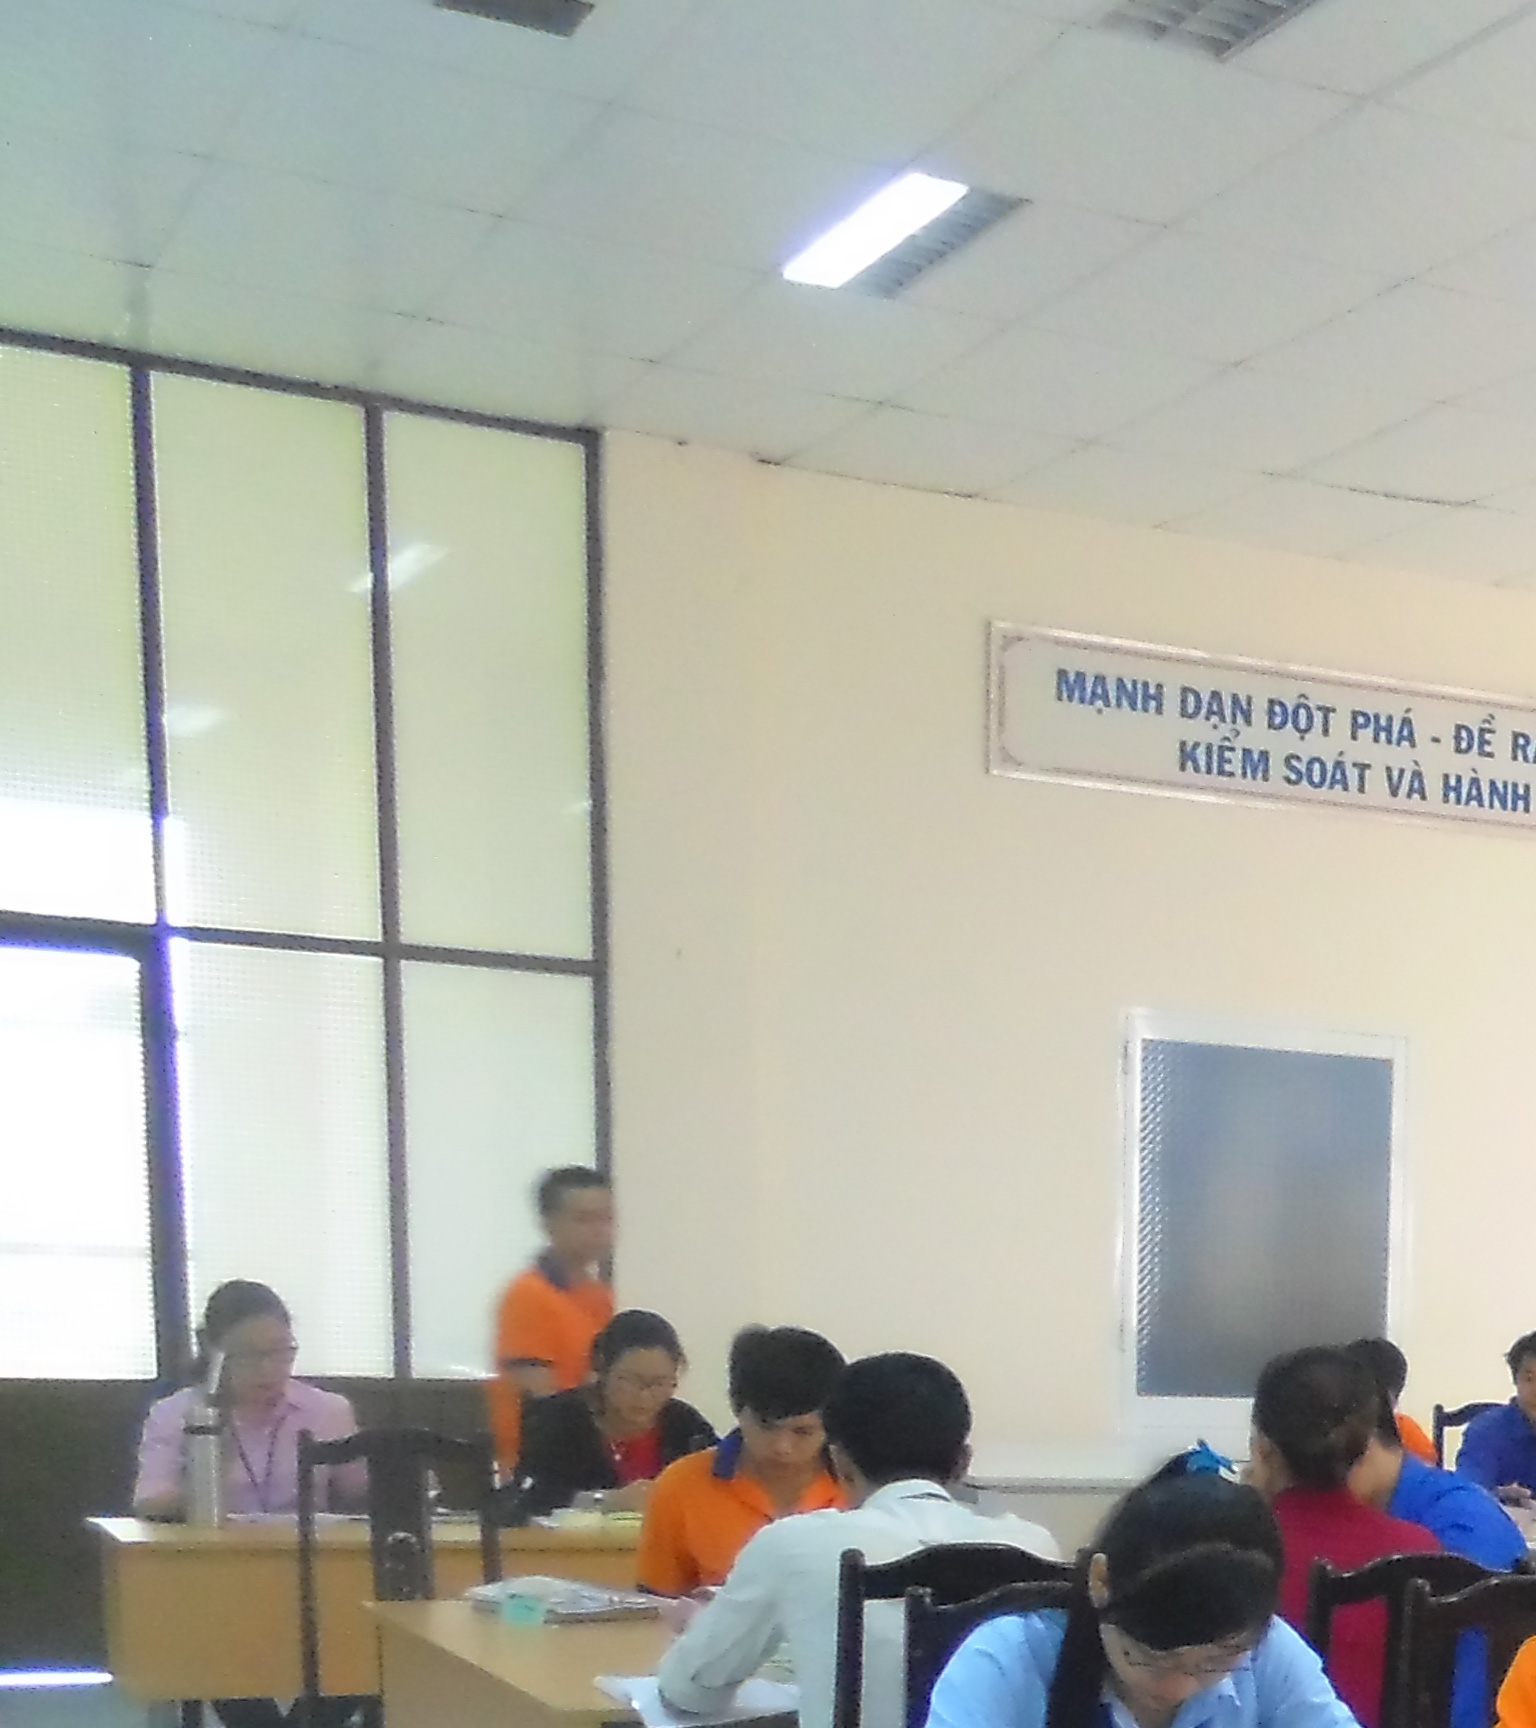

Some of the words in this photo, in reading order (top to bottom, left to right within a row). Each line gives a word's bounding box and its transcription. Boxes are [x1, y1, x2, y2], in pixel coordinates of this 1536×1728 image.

[1056, 667, 1164, 715] MẠNH
[1179, 686, 1253, 731] DẠN
[1266, 693, 1336, 741] ĐỘT
[1351, 707, 1417, 750] PHÁ
[1453, 712, 1497, 760] ĐỀ
[1178, 728, 1271, 783] KIỂM
[1283, 750, 1371, 795] SOÁT
[1384, 760, 1428, 802] VÀ
[1442, 768, 1531, 814] HÀNH
